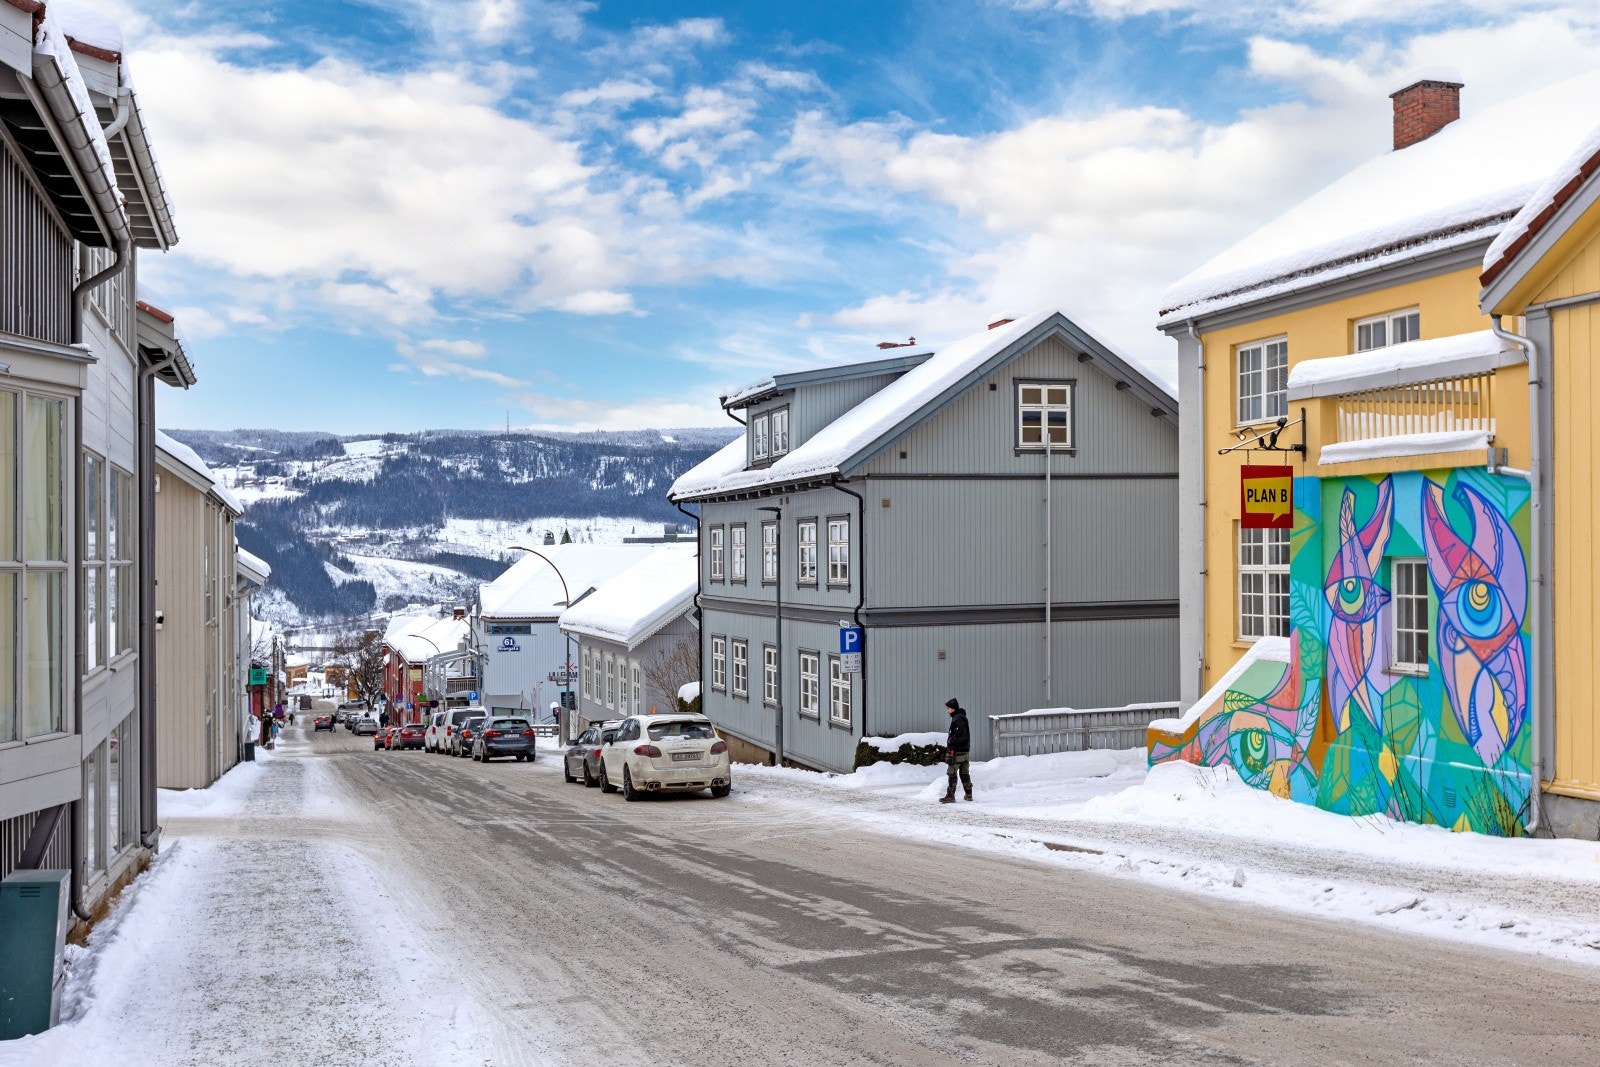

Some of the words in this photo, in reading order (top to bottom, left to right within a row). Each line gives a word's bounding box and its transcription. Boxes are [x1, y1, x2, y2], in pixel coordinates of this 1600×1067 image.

[1247, 488, 1276, 503] PLAN
[1280, 488, 1288, 503] B
[504, 638, 514, 646] 61
[845, 631, 858, 650] P
[470, 692, 477, 700] P
